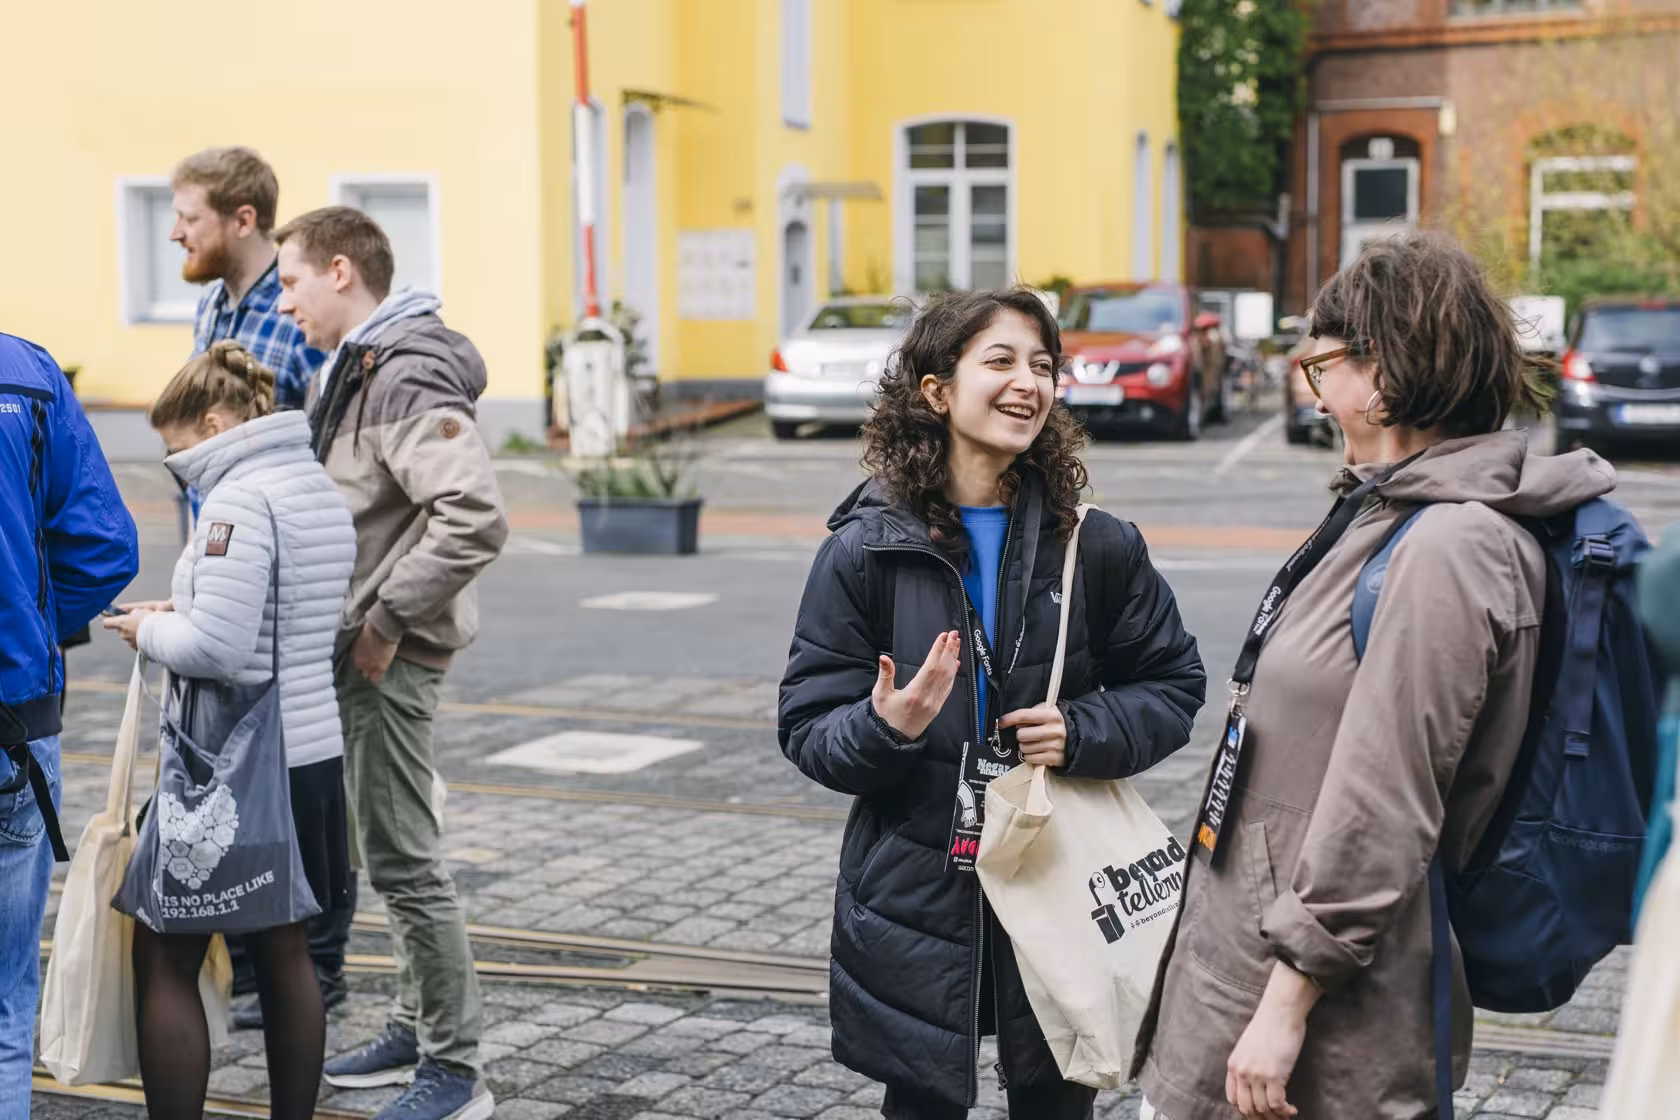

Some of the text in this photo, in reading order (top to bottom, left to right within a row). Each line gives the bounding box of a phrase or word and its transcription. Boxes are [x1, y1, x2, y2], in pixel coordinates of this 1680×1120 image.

[1262, 585, 1282, 612] Google
[974, 629, 993, 676] Google Fonts
[164, 870, 275, 907] IS NO PLACE LIKE
[162, 900, 240, 918] 192.168.1.1
